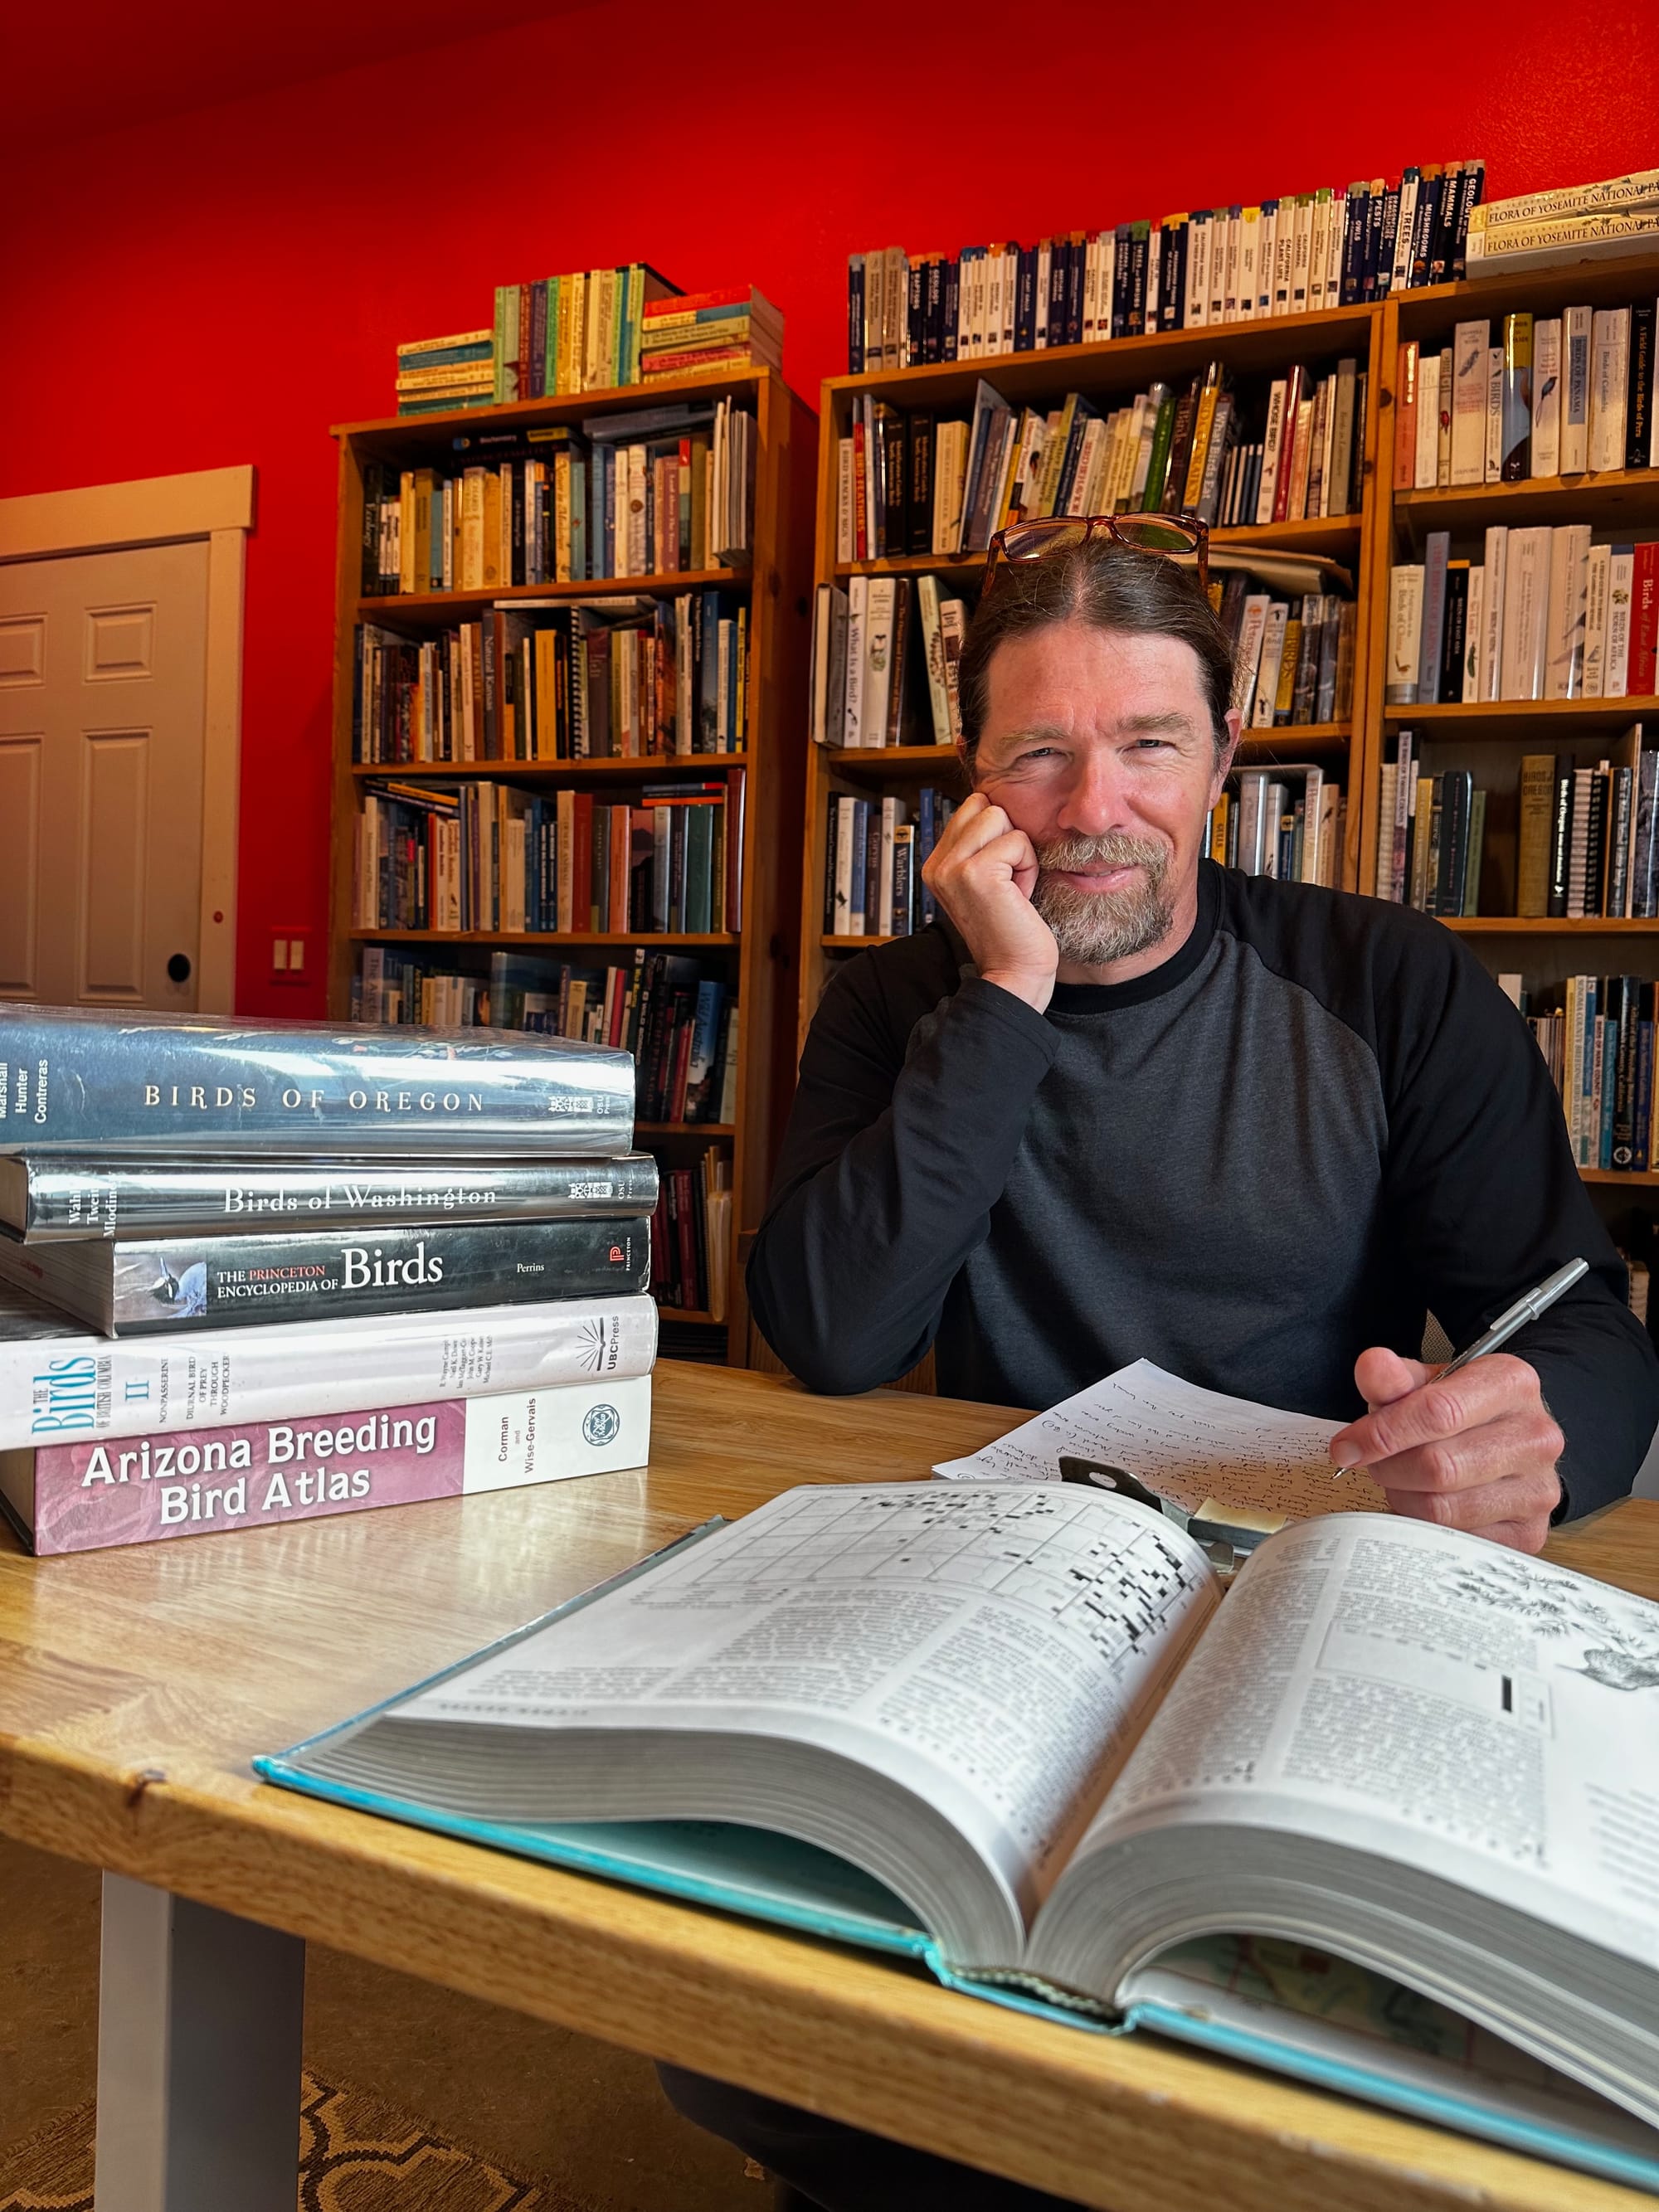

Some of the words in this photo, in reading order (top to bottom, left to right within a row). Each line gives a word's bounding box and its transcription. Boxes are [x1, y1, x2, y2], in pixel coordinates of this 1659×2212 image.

[1373, 199, 1382, 227] PESTS
[1389, 195, 1399, 239] DRAGONFLIES
[1443, 180, 1457, 227] MAMMALS
[1489, 207, 1520, 223] FLORA
[1522, 203, 1536, 216] OF
[1539, 197, 1588, 213] YOSEMITE
[1592, 186, 1644, 202] NATIONAL
[1354, 220, 1362, 241] OWLS
[1402, 211, 1413, 244] TREES
[1419, 203, 1433, 258] MUSHROOMS
[1488, 237, 1519, 252] FLORA
[1521, 234, 1536, 246] OF
[1537, 227, 1588, 245] YOSEMITE
[1590, 220, 1644, 236] NATIONAL
[1283, 239, 1292, 282] CALIFORNIA
[1638, 333, 1647, 350] Field
[1574, 366, 1582, 377] OF
[1602, 371, 1609, 379] of
[1637, 351, 1646, 370] Guide
[1270, 392, 1282, 425] WHOSE
[1490, 382, 1501, 417] BIRDS
[1573, 380, 1582, 413] PANAMA
[1636, 393, 1644, 411] Birds
[1175, 411, 1190, 445] Birds
[1211, 411, 1228, 444] What
[1267, 427, 1277, 452] BIRD?
[1634, 421, 1643, 438] Peru
[856, 451, 864, 477] BIRD
[1055, 436, 1068, 465] Better
[1204, 446, 1219, 478] Birds
[557, 460, 567, 491] Nature
[842, 474, 850, 506] TRACKS
[1046, 468, 1063, 503] Birding
[1201, 480, 1214, 498] Eat
[856, 479, 865, 532] FEATHERS
[363, 503, 377, 548] Ecology
[1399, 589, 1407, 611] Birds
[1641, 579, 1653, 610] Birds
[1397, 613, 1406, 624] of
[1618, 611, 1626, 633] BIRDS
[1640, 612, 1651, 623] of
[849, 628, 859, 655] What
[1618, 634, 1624, 643] OF
[1640, 624, 1651, 644] East
[484, 635, 494, 673] Natural
[849, 659, 858, 668] Is
[1282, 638, 1298, 680] BIRDS
[1609, 645, 1618, 671] AFRICA
[1637, 647, 1652, 678] Africa
[485, 675, 494, 711] Kansas
[849, 678, 857, 703] Bird?
[1559, 778, 1569, 797] Birds
[1559, 797, 1569, 806] of
[1306, 789, 1317, 829] Peterson
[1557, 807, 1568, 833] Oregon
[871, 832, 880, 868] Corvus
[896, 848, 907, 897] Warblers
[369, 959, 378, 978] The
[1576, 979, 1584, 1011] SONOMA
[639, 1002, 647, 1025] WILD
[1575, 1012, 1584, 1043] COUNTY
[690, 1018, 707, 1068] Australia
[1595, 1041, 1601, 1049] OF
[1574, 1044, 1583, 1083] BREEDING
[1617, 1046, 1627, 1074] County,
[1627, 1048, 1636, 1082] Breeding
[15, 1068, 28, 1114] Hunter
[34, 1059, 48, 1124] Contreras
[144, 1085, 256, 1109] BIRDS
[282, 1089, 325, 1108] OF
[348, 1091, 484, 1112] OREGON
[1617, 1075, 1625, 1114] California
[1572, 1102, 1580, 1128] ATLAS
[69, 1190, 82, 1225] Wahl
[224, 1188, 299, 1213] Birds
[308, 1188, 332, 1210] of
[343, 1184, 497, 1210] Washington
[217, 1271, 246, 1284] THE
[249, 1265, 326, 1281] PRINCETON
[341, 1242, 444, 1290] Birds
[517, 1262, 545, 1273] Perrins
[217, 1282, 318, 1299] ENCYCLOPEDIA
[322, 1279, 339, 1291] OF
[125, 1380, 149, 1400] II
[199, 1367, 207, 1389] PREY
[210, 1361, 219, 1407] THROUGH
[219, 1354, 231, 1415] WOODPECKER
[32, 1356, 96, 1434] Birds
[33, 1387, 48, 1405] THE
[186, 1382, 197, 1420] DIURNAL
[199, 1390, 207, 1403] OF
[81, 1439, 252, 1486] Arizona
[267, 1414, 436, 1464] Breeding
[499, 1417, 509, 1462] Corman
[524, 1398, 537, 1473] Wise-Gervais
[160, 1478, 247, 1525] Bird
[260, 1466, 372, 1510] Atlas
